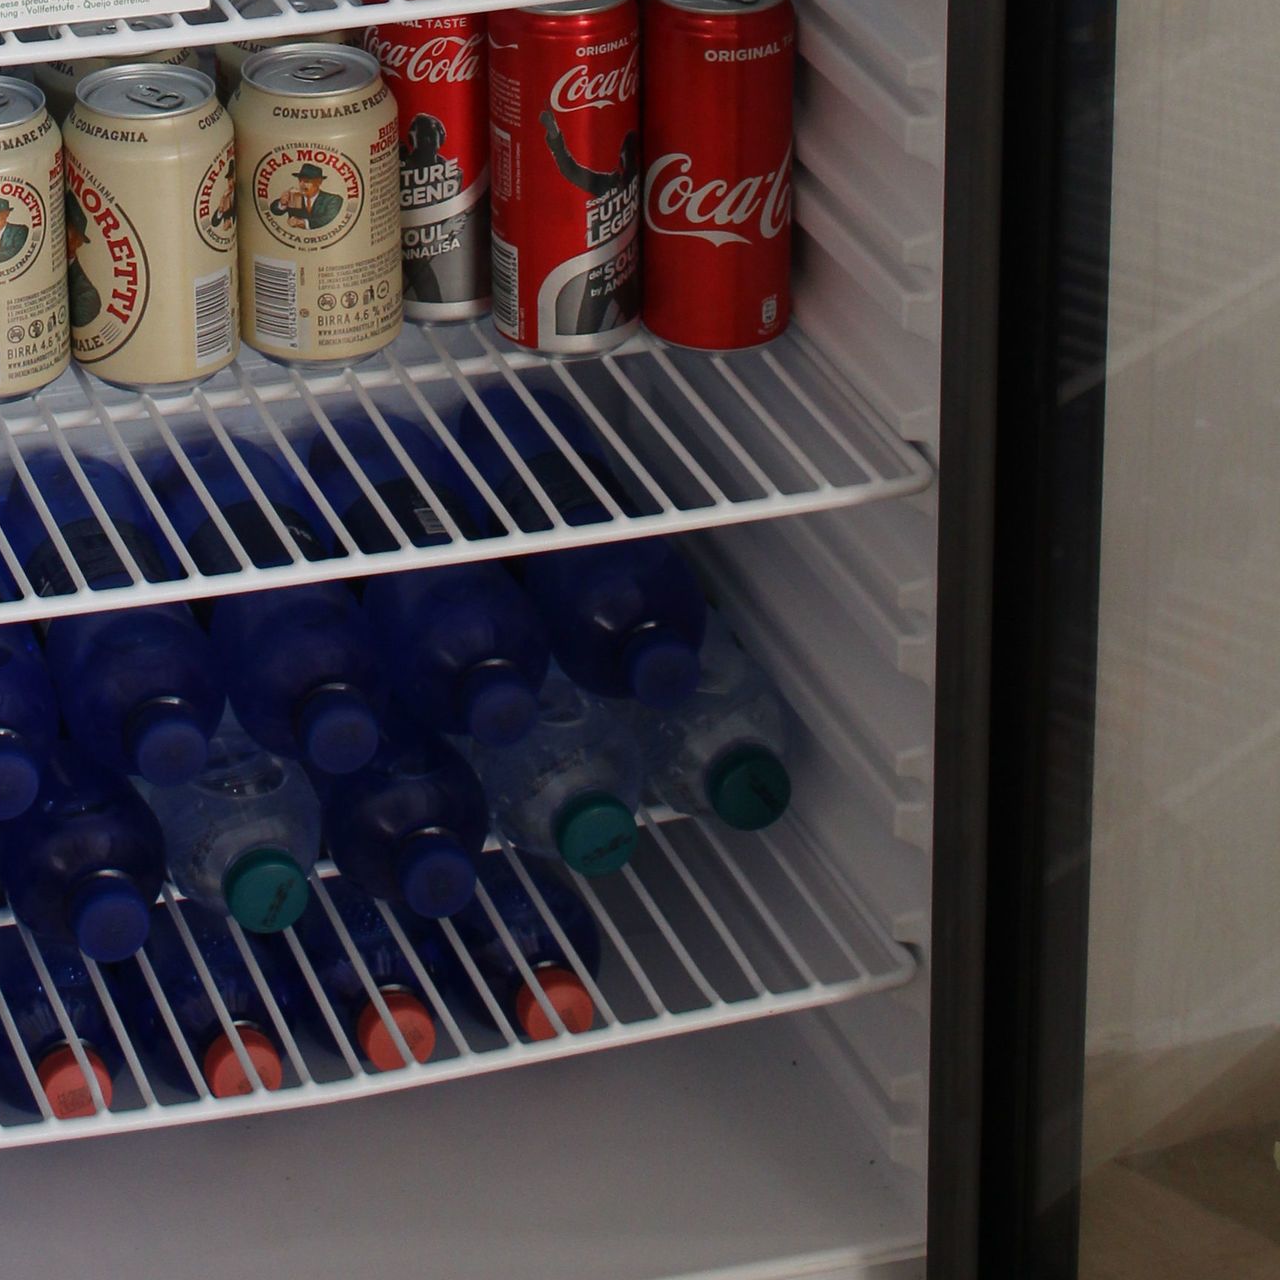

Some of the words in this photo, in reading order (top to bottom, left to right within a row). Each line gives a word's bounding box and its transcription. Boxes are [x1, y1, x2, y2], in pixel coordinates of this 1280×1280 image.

[26, 3, 74, 15] Vollfettstufe
[83, 0, 112, 10] Queijo
[425, 17, 468, 29] TASTE
[575, 37, 629, 57] ORIGINAL
[704, 42, 782, 63] ORIGINAL
[272, 102, 361, 120] CONSUMARE
[74, 119, 148, 143] COMPAGNIA
[256, 151, 294, 200] BIRRA
[296, 149, 360, 201] MORETTI
[399, 157, 460, 185] TURE
[198, 158, 226, 219] BIRRA
[399, 181, 460, 207] GEND
[264, 210, 302, 244] RICETTA
[303, 211, 353, 245] ORIGINALE
[405, 225, 449, 246] OUL
[67, 163, 139, 325] MORETTI
[317, 313, 351, 327] BIRRA
[7, 343, 38, 360] BIRRA
